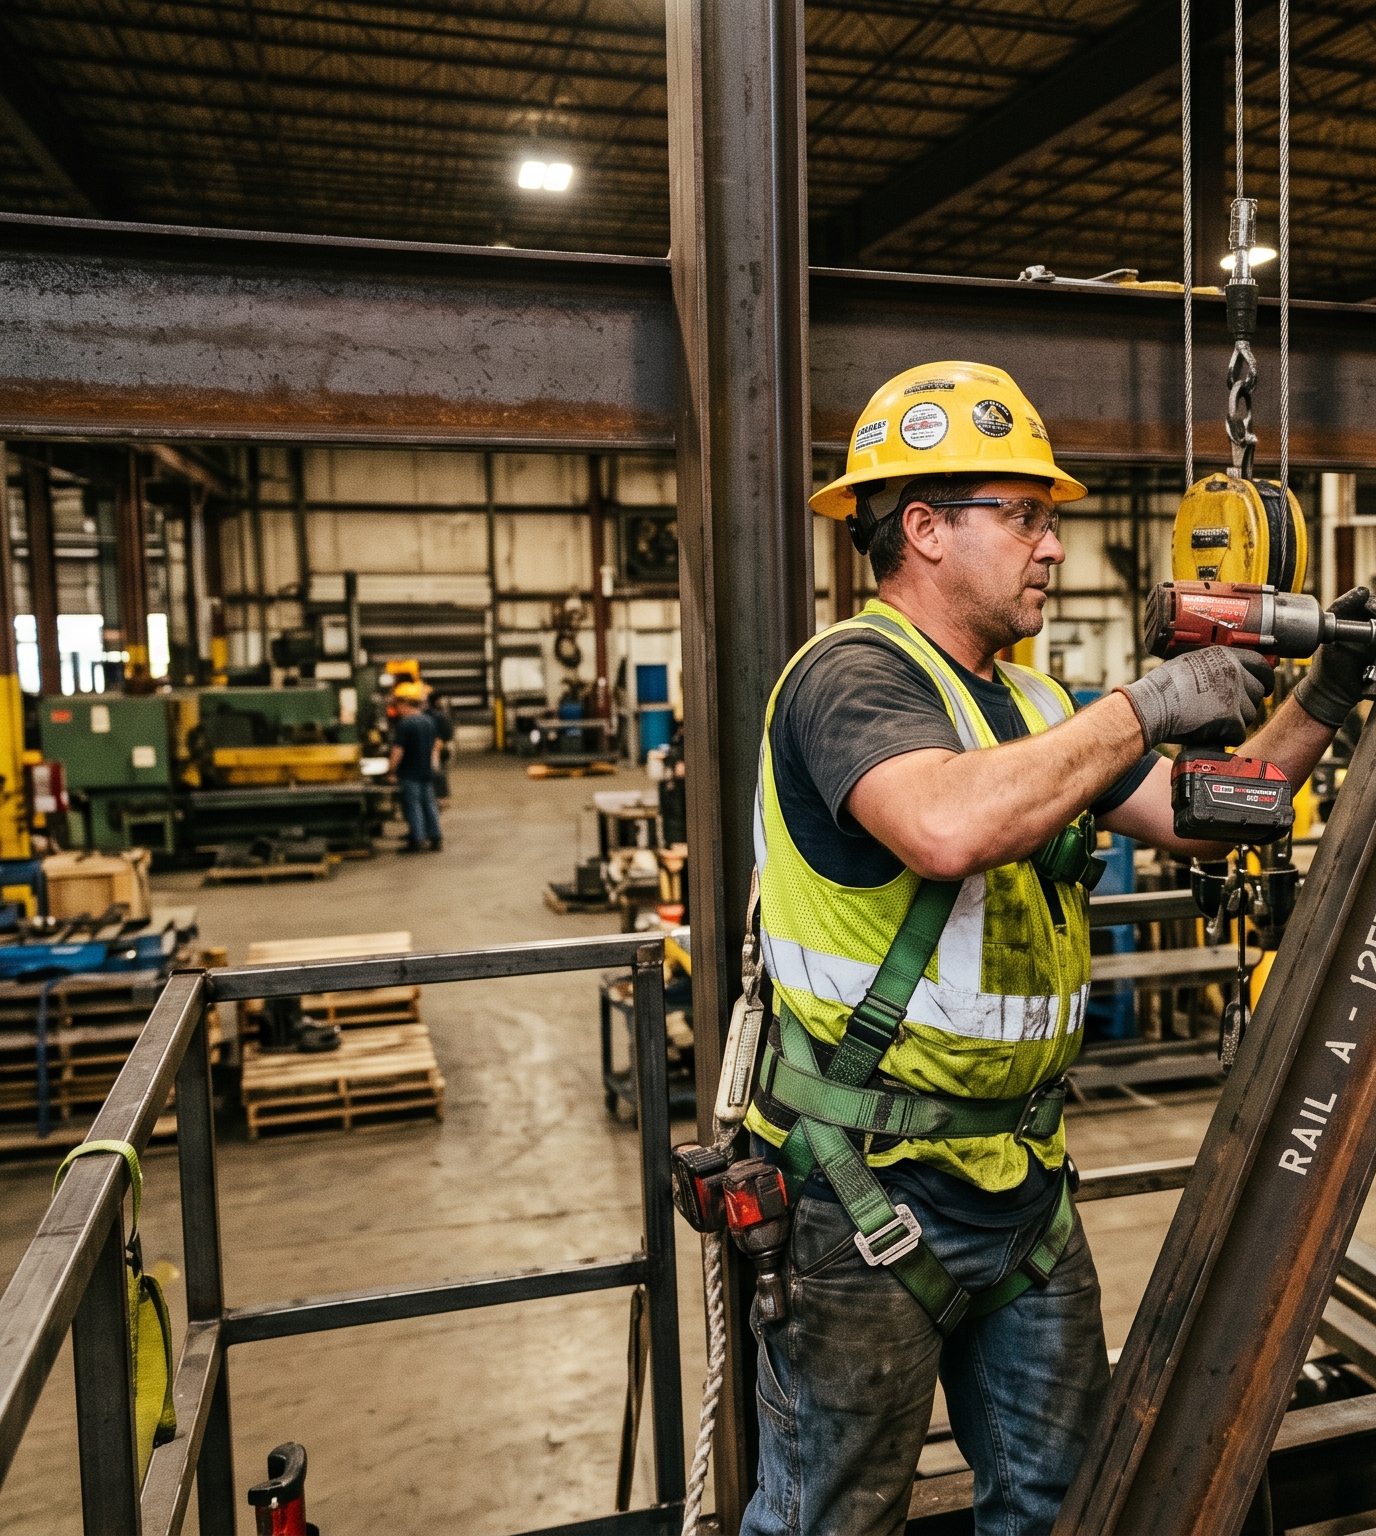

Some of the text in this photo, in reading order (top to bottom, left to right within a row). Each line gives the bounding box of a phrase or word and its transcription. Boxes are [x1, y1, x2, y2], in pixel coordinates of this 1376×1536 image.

[1278, 1093, 1338, 1176] RAIL
[1325, 1041, 1357, 1064] A
[1348, 1007, 1358, 1021] -
